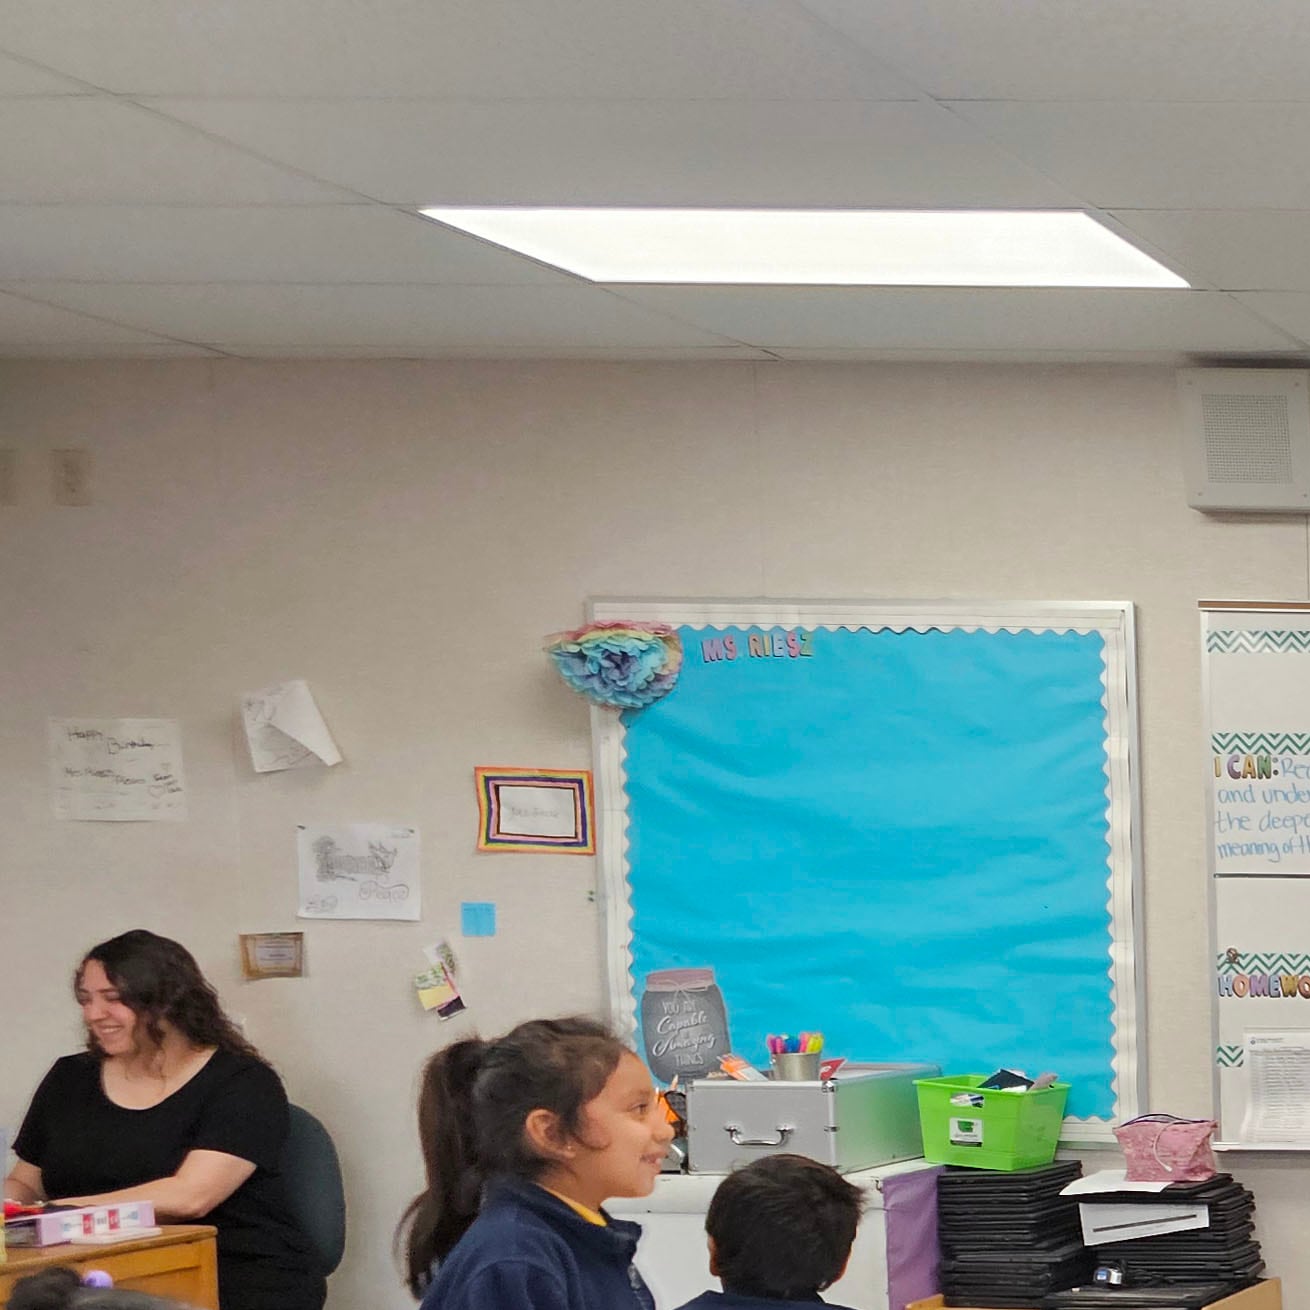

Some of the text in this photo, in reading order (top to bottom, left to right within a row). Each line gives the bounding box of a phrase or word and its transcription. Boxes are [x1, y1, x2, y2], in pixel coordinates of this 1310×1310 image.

[701, 635, 737, 663] MS
[1214, 756, 1222, 778] I
[1227, 754, 1279, 780] CAN:
[1217, 783, 1256, 804] and
[1215, 810, 1251, 832] the
